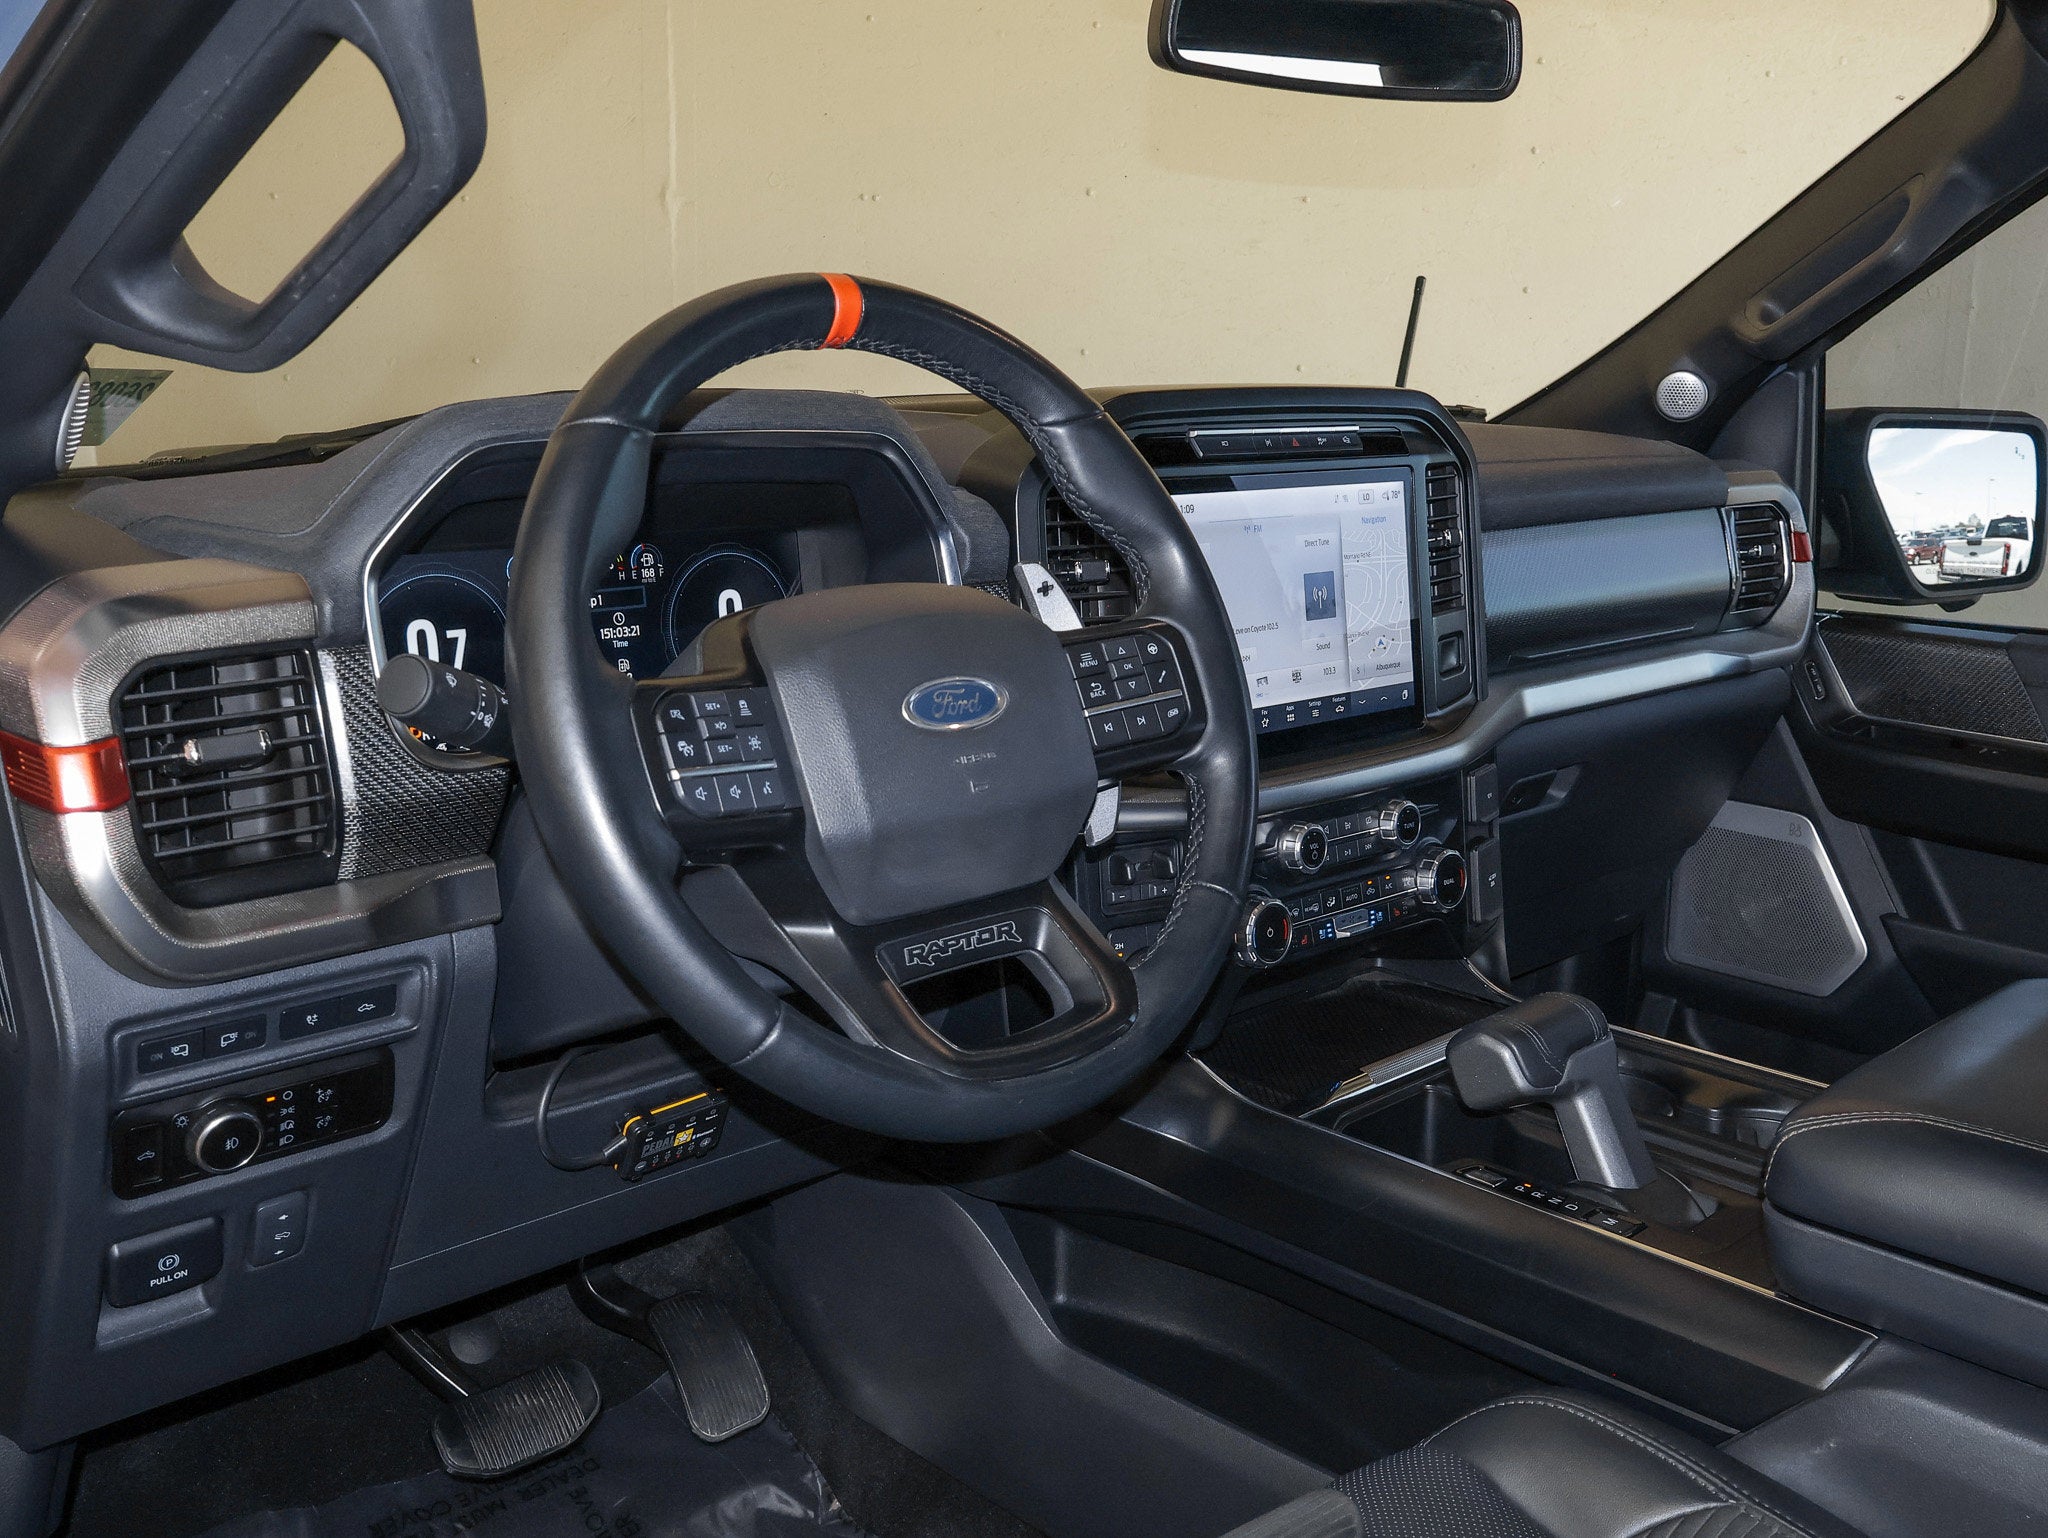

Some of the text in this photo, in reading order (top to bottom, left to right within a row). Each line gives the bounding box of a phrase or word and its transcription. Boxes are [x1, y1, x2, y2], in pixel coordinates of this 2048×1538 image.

[1361, 516, 1387, 524] Navigation
[618, 572, 626, 580] H
[631, 570, 638, 579] E
[641, 568, 655, 578] 168
[659, 568, 665, 577] F
[600, 625, 640, 640] 151:03:21
[612, 640, 629, 648] Time
[1316, 642, 1331, 651] Sound
[1080, 659, 1099, 669] MENU
[1089, 690, 1107, 699] BACK
[931, 687, 982, 718] Ford
[1309, 842, 1320, 850] VOL
[1384, 882, 1393, 890] A/C
[1443, 878, 1455, 886] DUAL
[1345, 893, 1358, 902] AUTO
[904, 920, 1022, 967] RAPTOR
[1114, 942, 1124, 950] 2H
[150, 1268, 188, 1288] PULL ON
